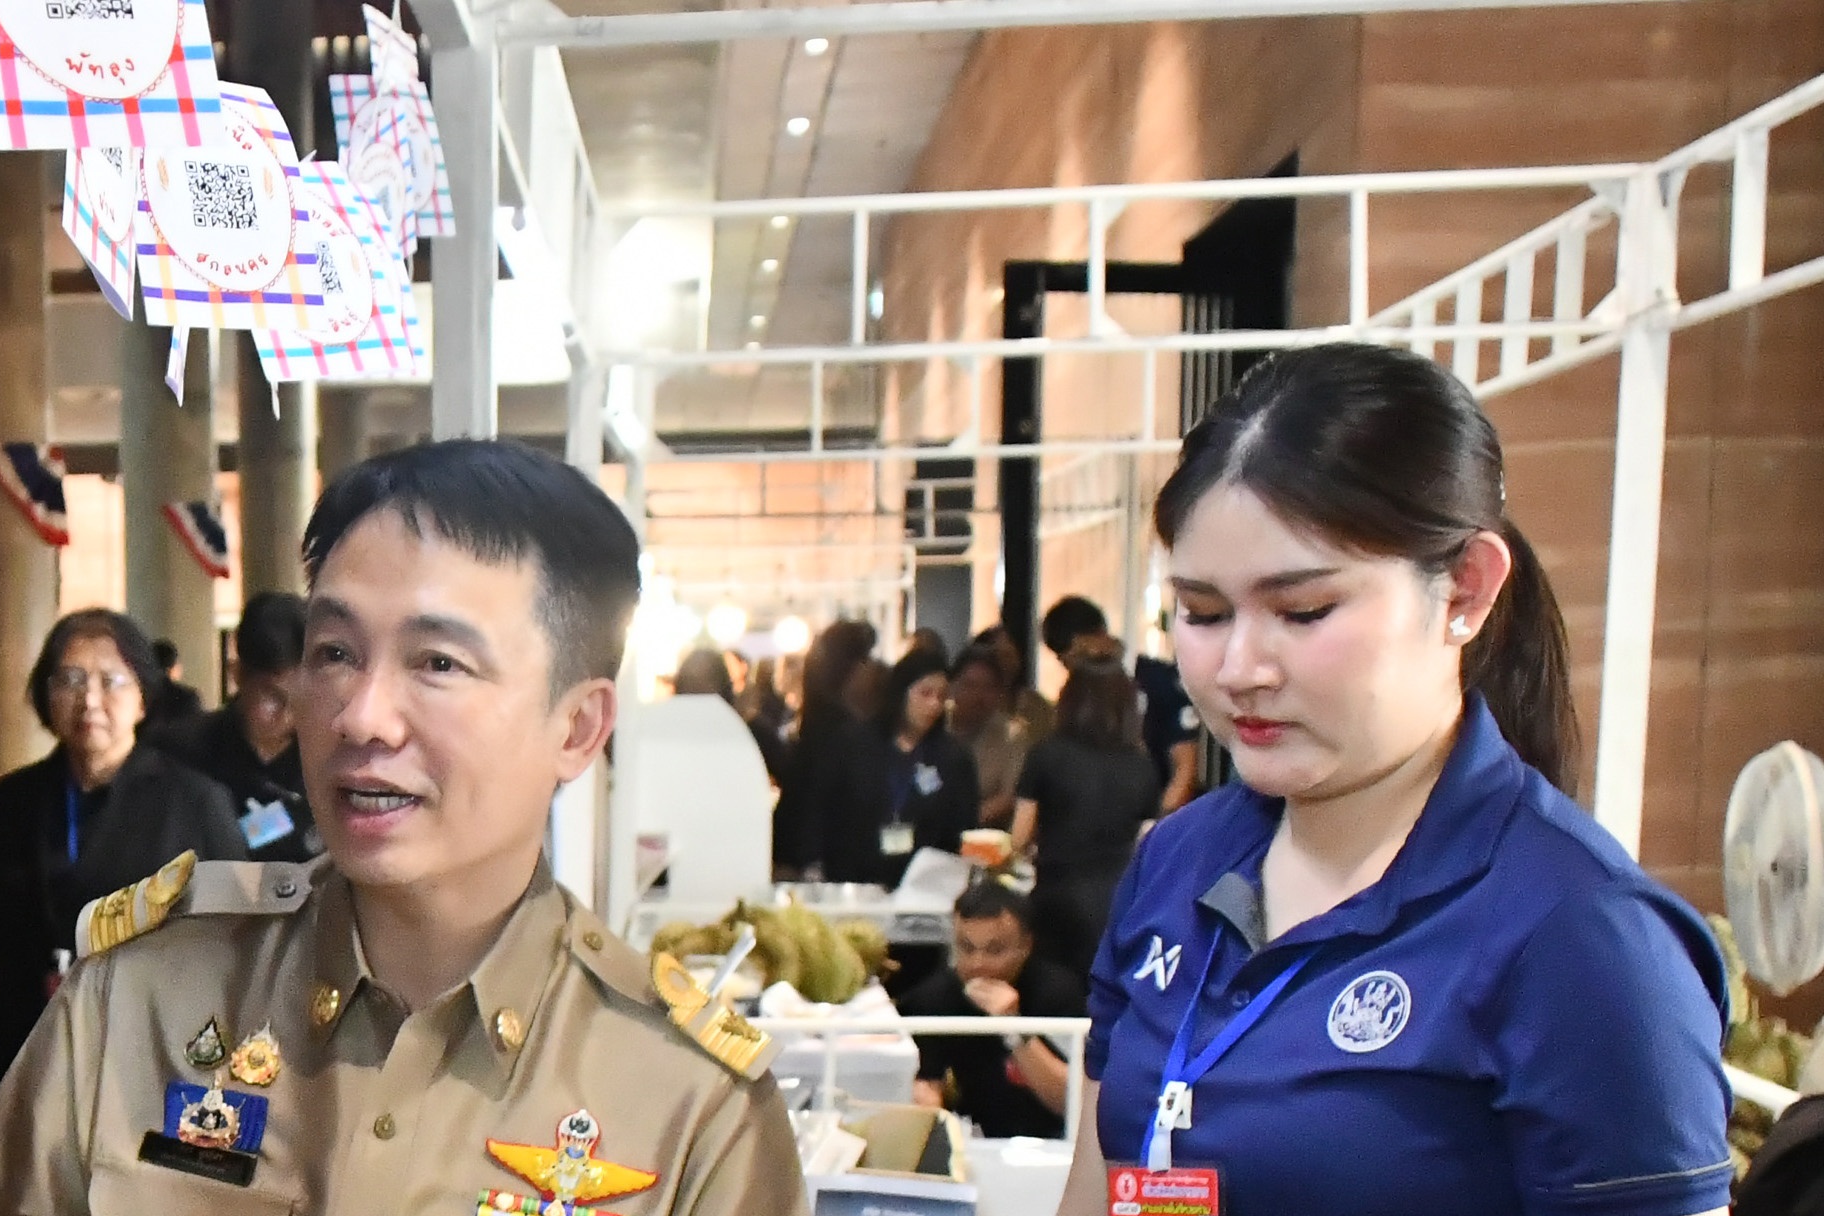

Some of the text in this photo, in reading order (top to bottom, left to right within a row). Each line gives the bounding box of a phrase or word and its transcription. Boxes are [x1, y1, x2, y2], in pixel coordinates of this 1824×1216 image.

[65, 52, 135, 86] พัทลุง
[196, 252, 269, 276] สกลนคร
